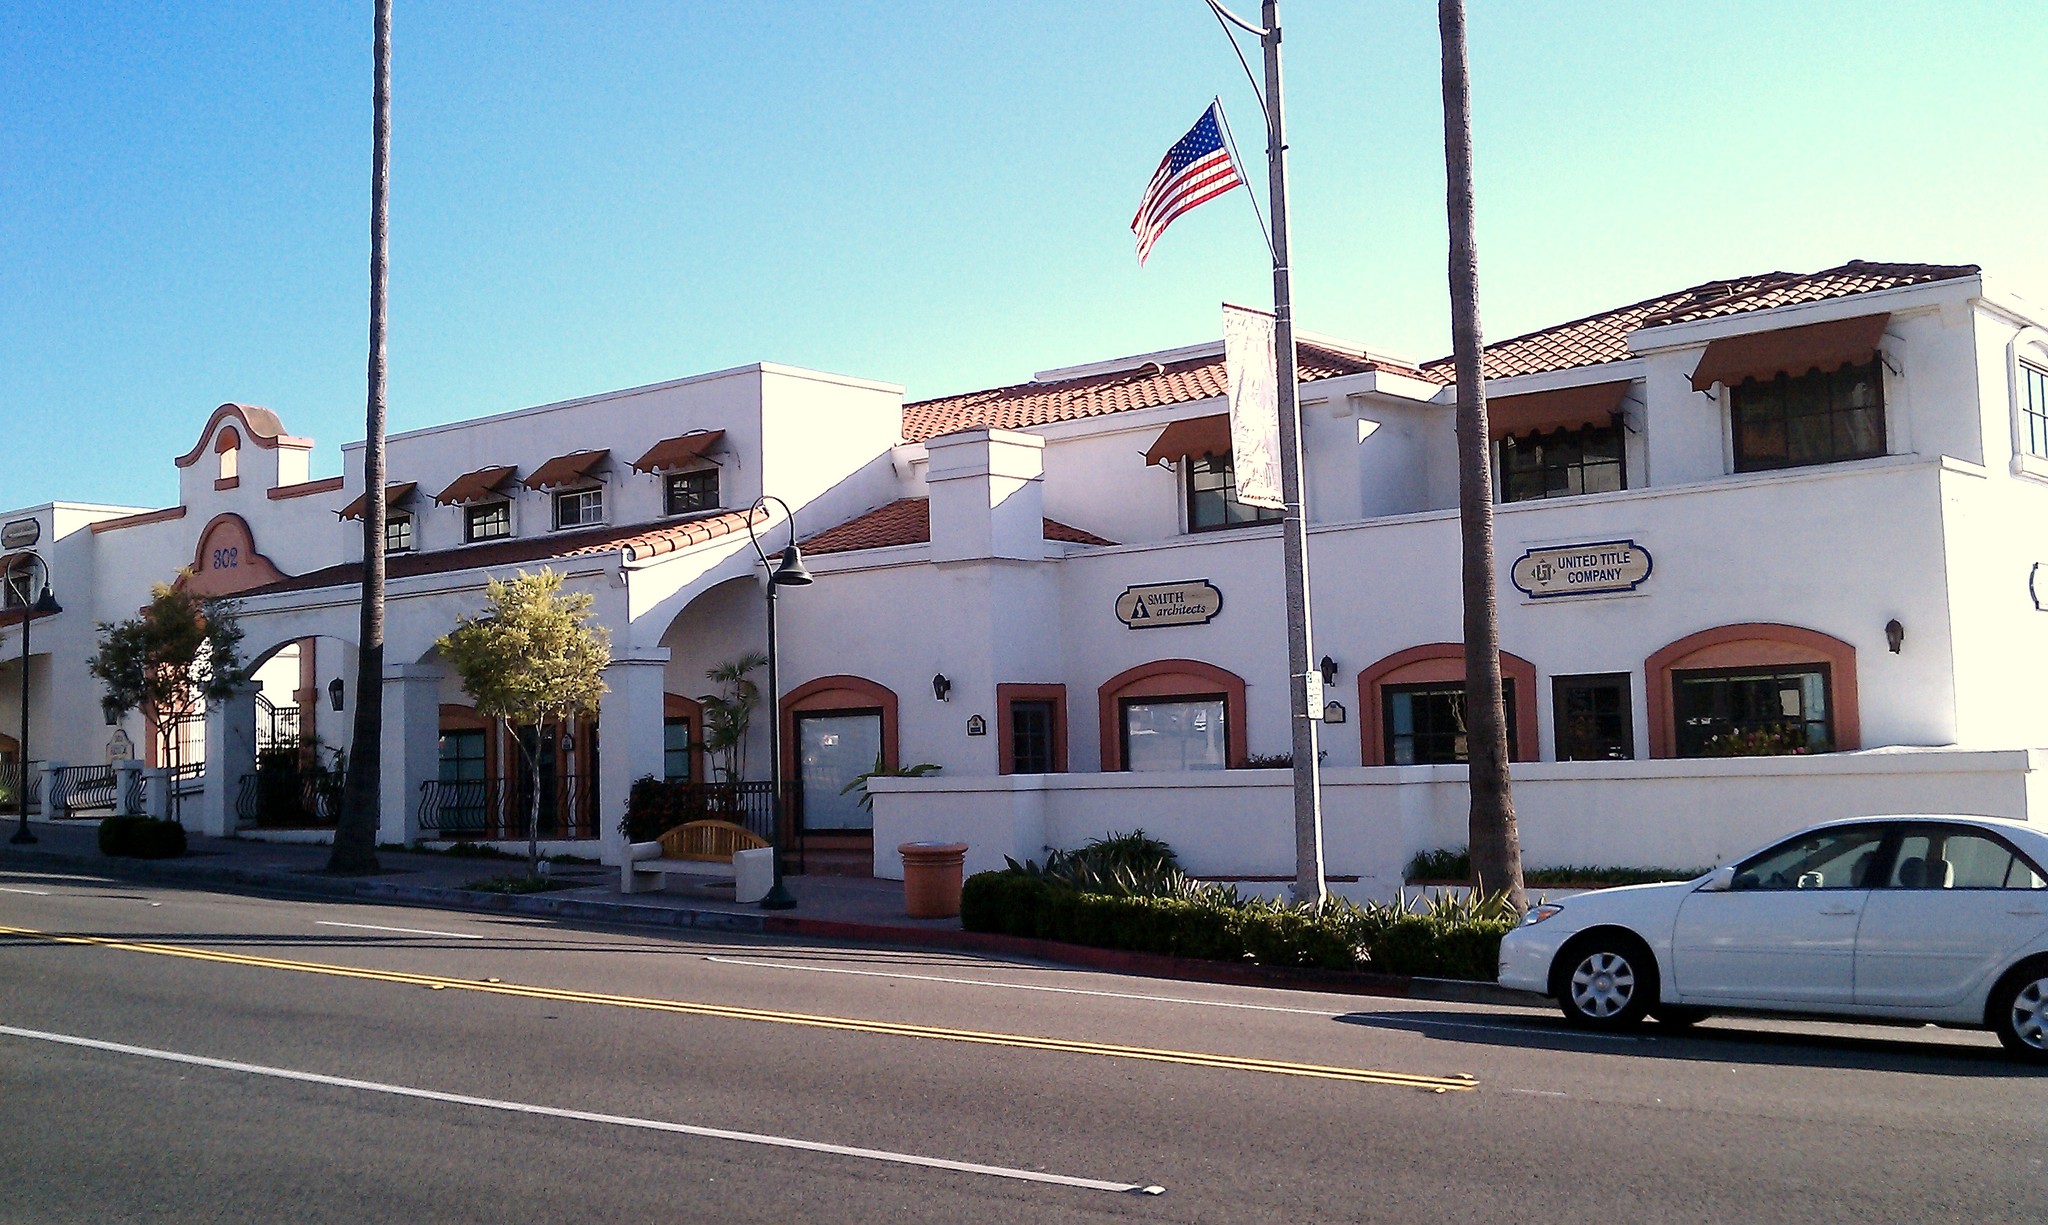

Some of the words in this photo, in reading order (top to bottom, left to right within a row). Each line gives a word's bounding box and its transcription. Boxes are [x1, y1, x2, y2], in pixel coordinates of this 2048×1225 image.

[213, 547, 238, 570] 302
[1558, 554, 1598, 570] UNITED
[1600, 551, 1631, 566] TITLE
[1567, 567, 1622, 584] COMPANY
[1147, 591, 1185, 606] SMITH
[1156, 604, 1206, 617] architects
